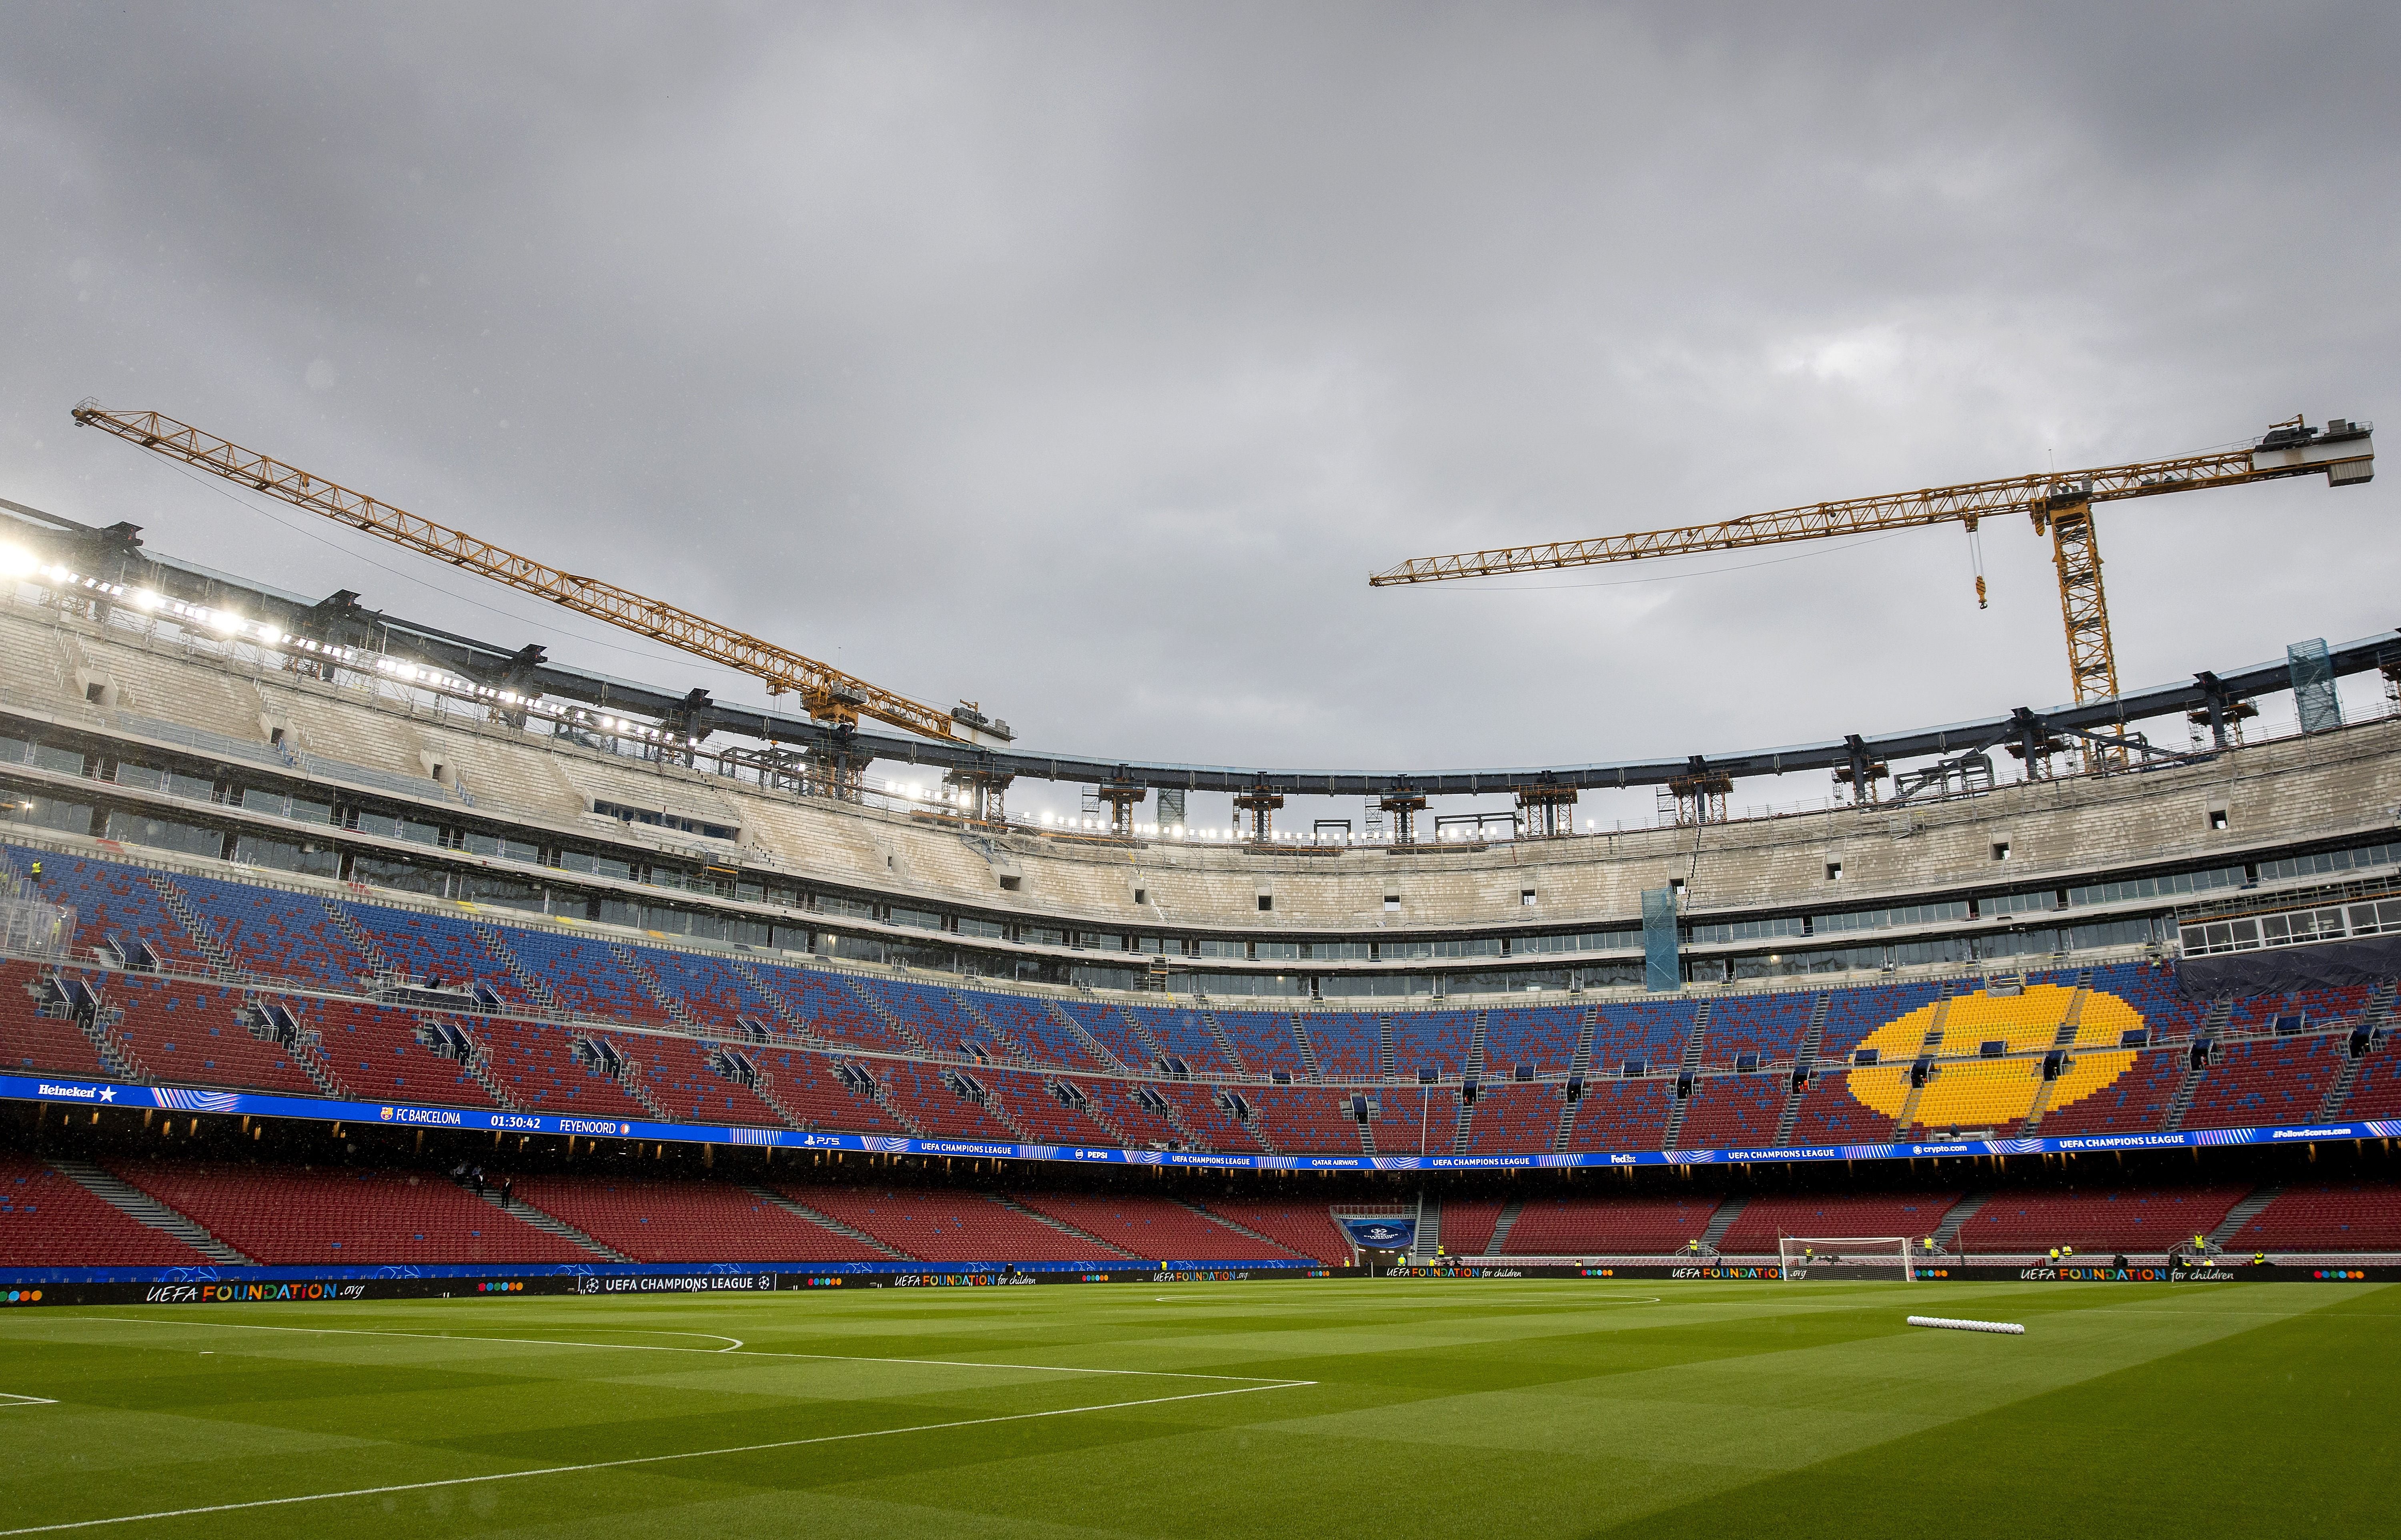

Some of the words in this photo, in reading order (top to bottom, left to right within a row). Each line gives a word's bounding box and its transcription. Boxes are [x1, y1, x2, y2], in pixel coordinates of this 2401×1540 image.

[38, 1085, 96, 1097] Heineken
[397, 1109, 407, 1121] FC
[409, 1109, 460, 1125] BARCELONA
[491, 1115, 540, 1129] 01:30:42
[560, 1119, 615, 1134] FEYENOORD
[2086, 1137, 2144, 1147] CHAMPIONS
[2146, 1135, 2185, 1144] LEAGUE
[941, 1144, 983, 1153] CHAMPIONS
[1751, 1150, 1800, 1158] CHAMPIONS
[1924, 1145, 1967, 1153] crypto.com
[1611, 1154, 1636, 1163] FedEx
[1154, 1272, 1174, 1282] UEFA
[1176, 1271, 1235, 1281] FOUNDATION
[1237, 1272, 1248, 1281] .org
[1387, 1268, 1410, 1277] UEFA
[1413, 1268, 1479, 1277] FOUNDATION
[1482, 1268, 1492, 1279] for
[1494, 1269, 1521, 1277] children
[1672, 1268, 1700, 1278] UEFA
[1704, 1268, 1787, 1278] FOUNDATION
[1790, 1270, 1807, 1279] .org
[2021, 1269, 2055, 1279] UEFA
[2060, 1269, 2166, 1280] FOUNDATION
[2171, 1269, 2187, 1282] for
[2191, 1269, 2233, 1280] children
[606, 1280, 637, 1290] UEFA
[641, 1278, 707, 1289] CHAMPIONS
[712, 1278, 753, 1288] LEAGUE
[895, 1276, 920, 1286] UEFA
[923, 1274, 994, 1286] FOUNDATION
[998, 1275, 1008, 1286] for
[1010, 1275, 1036, 1285] children
[146, 1286, 198, 1302] UEFA
[203, 1284, 337, 1301] FOUNDATION
[340, 1285, 365, 1299] .org
